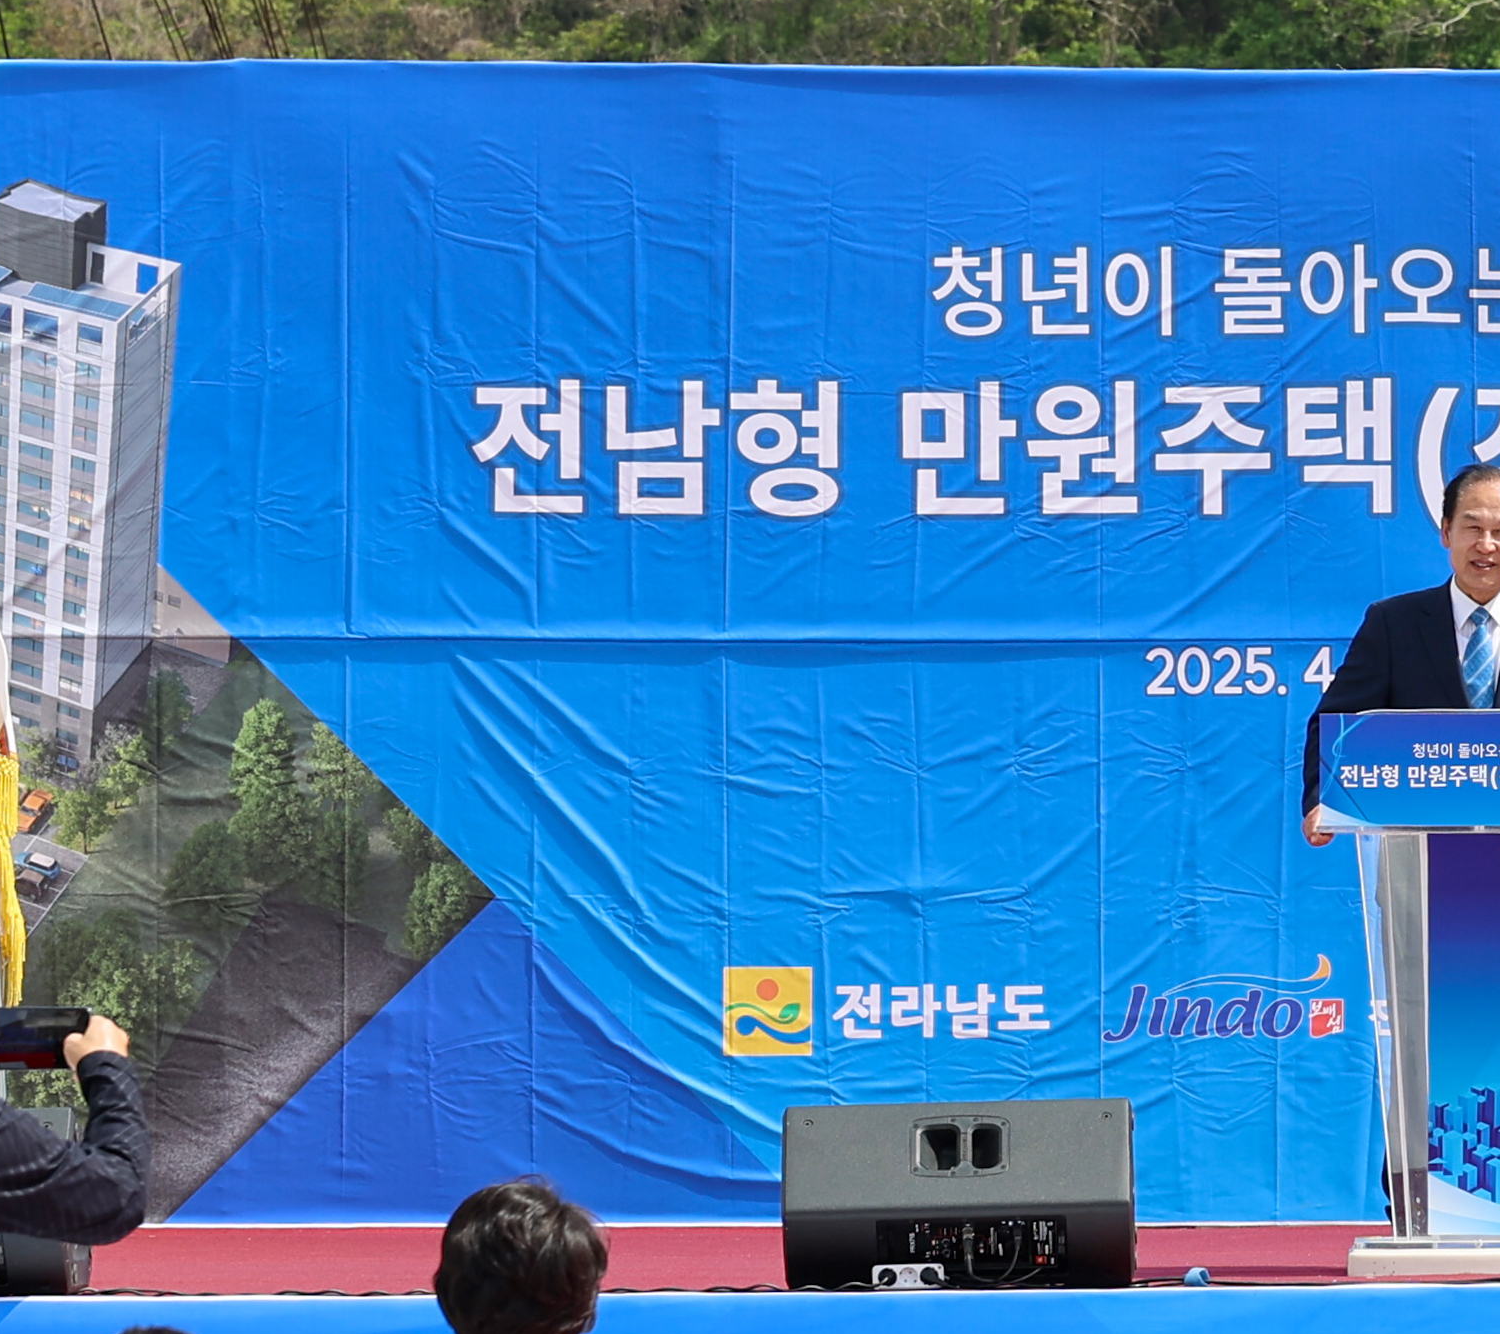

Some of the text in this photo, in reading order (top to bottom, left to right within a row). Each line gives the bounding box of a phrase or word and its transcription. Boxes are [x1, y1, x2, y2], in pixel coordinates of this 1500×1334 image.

[933, 247, 1172, 336] 청년이
[472, 379, 838, 516] 전남형
[1146, 647, 1287, 695] 2025.
[1340, 764, 1399, 788] 전남형
[1412, 742, 1453, 759] 청년이
[833, 984, 1051, 1039] 전라남도
[1103, 985, 1304, 1040] Jindo
